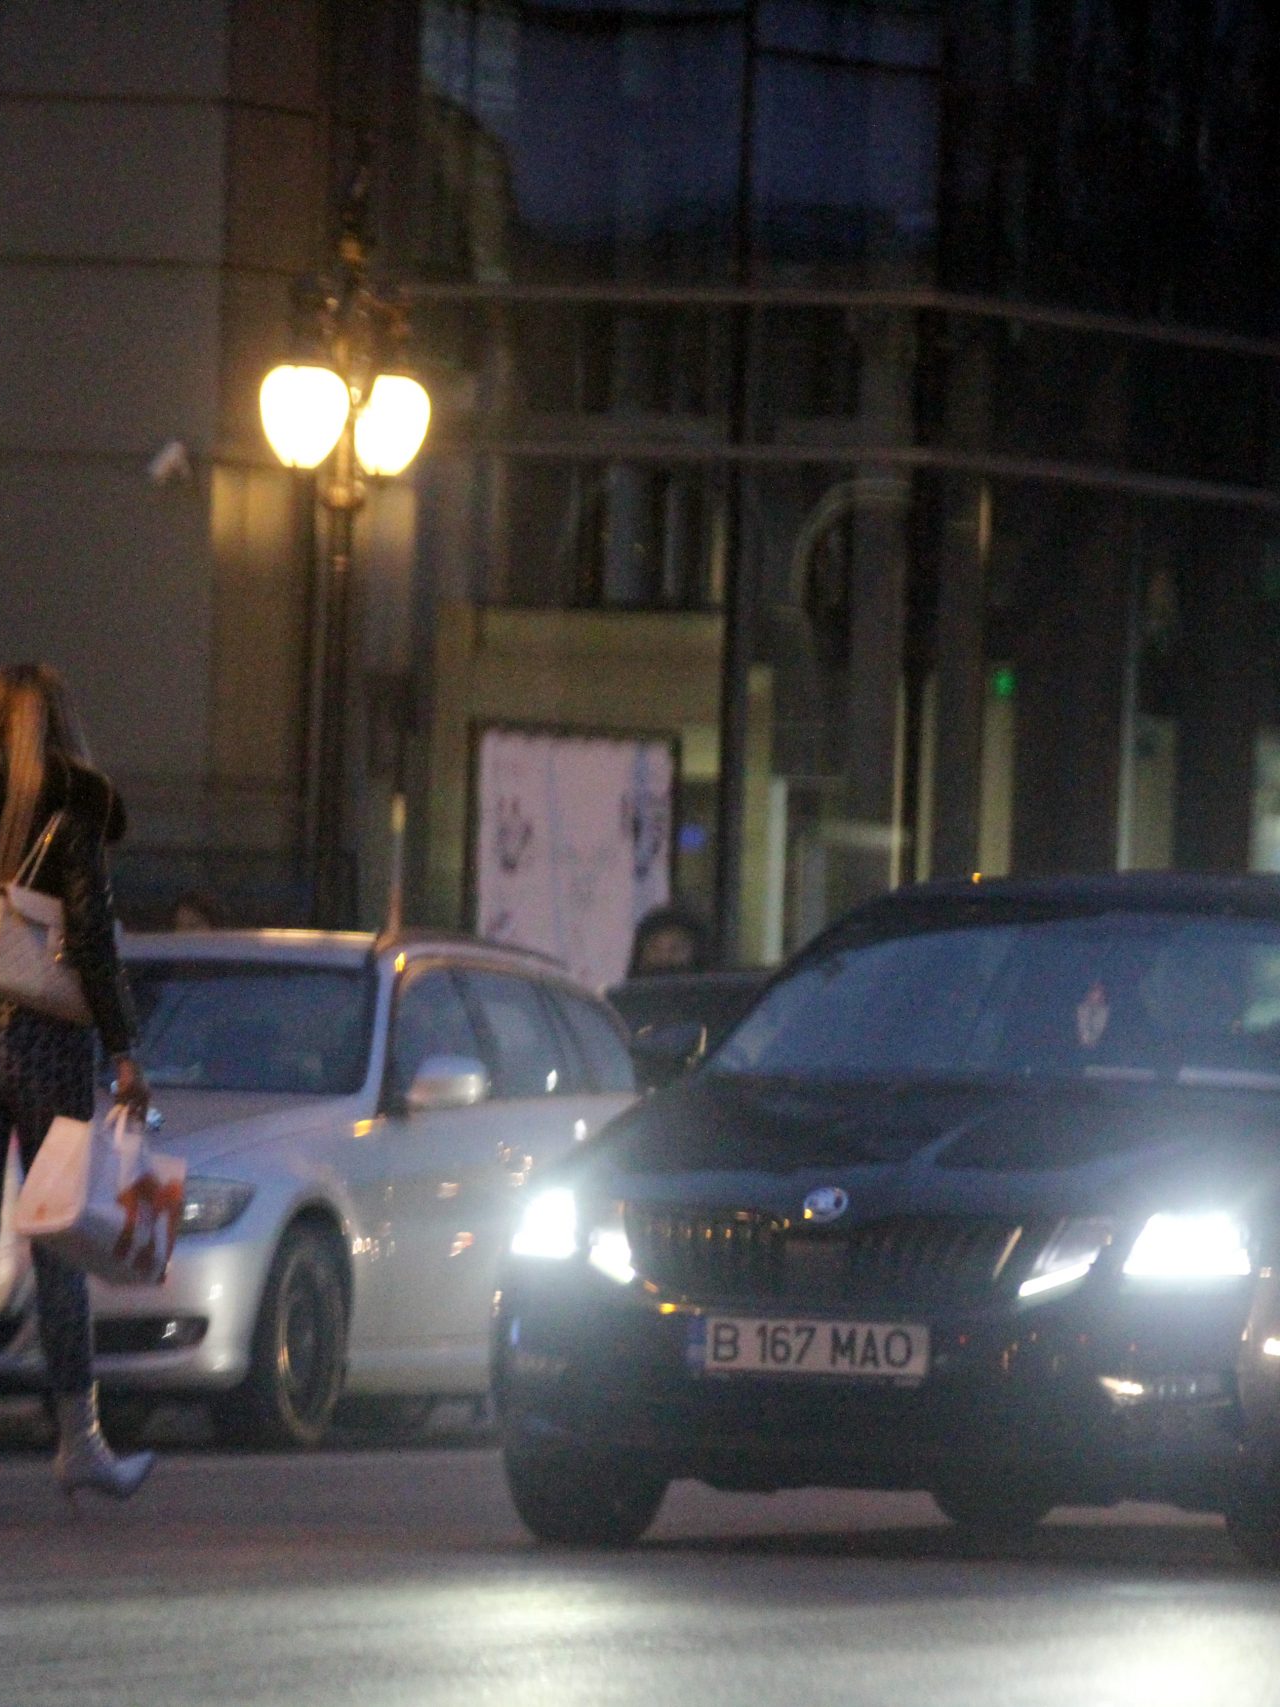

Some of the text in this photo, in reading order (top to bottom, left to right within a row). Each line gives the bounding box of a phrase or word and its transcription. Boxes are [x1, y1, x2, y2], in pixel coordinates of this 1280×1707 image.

[713, 1322, 913, 1367] B 167 MAO
